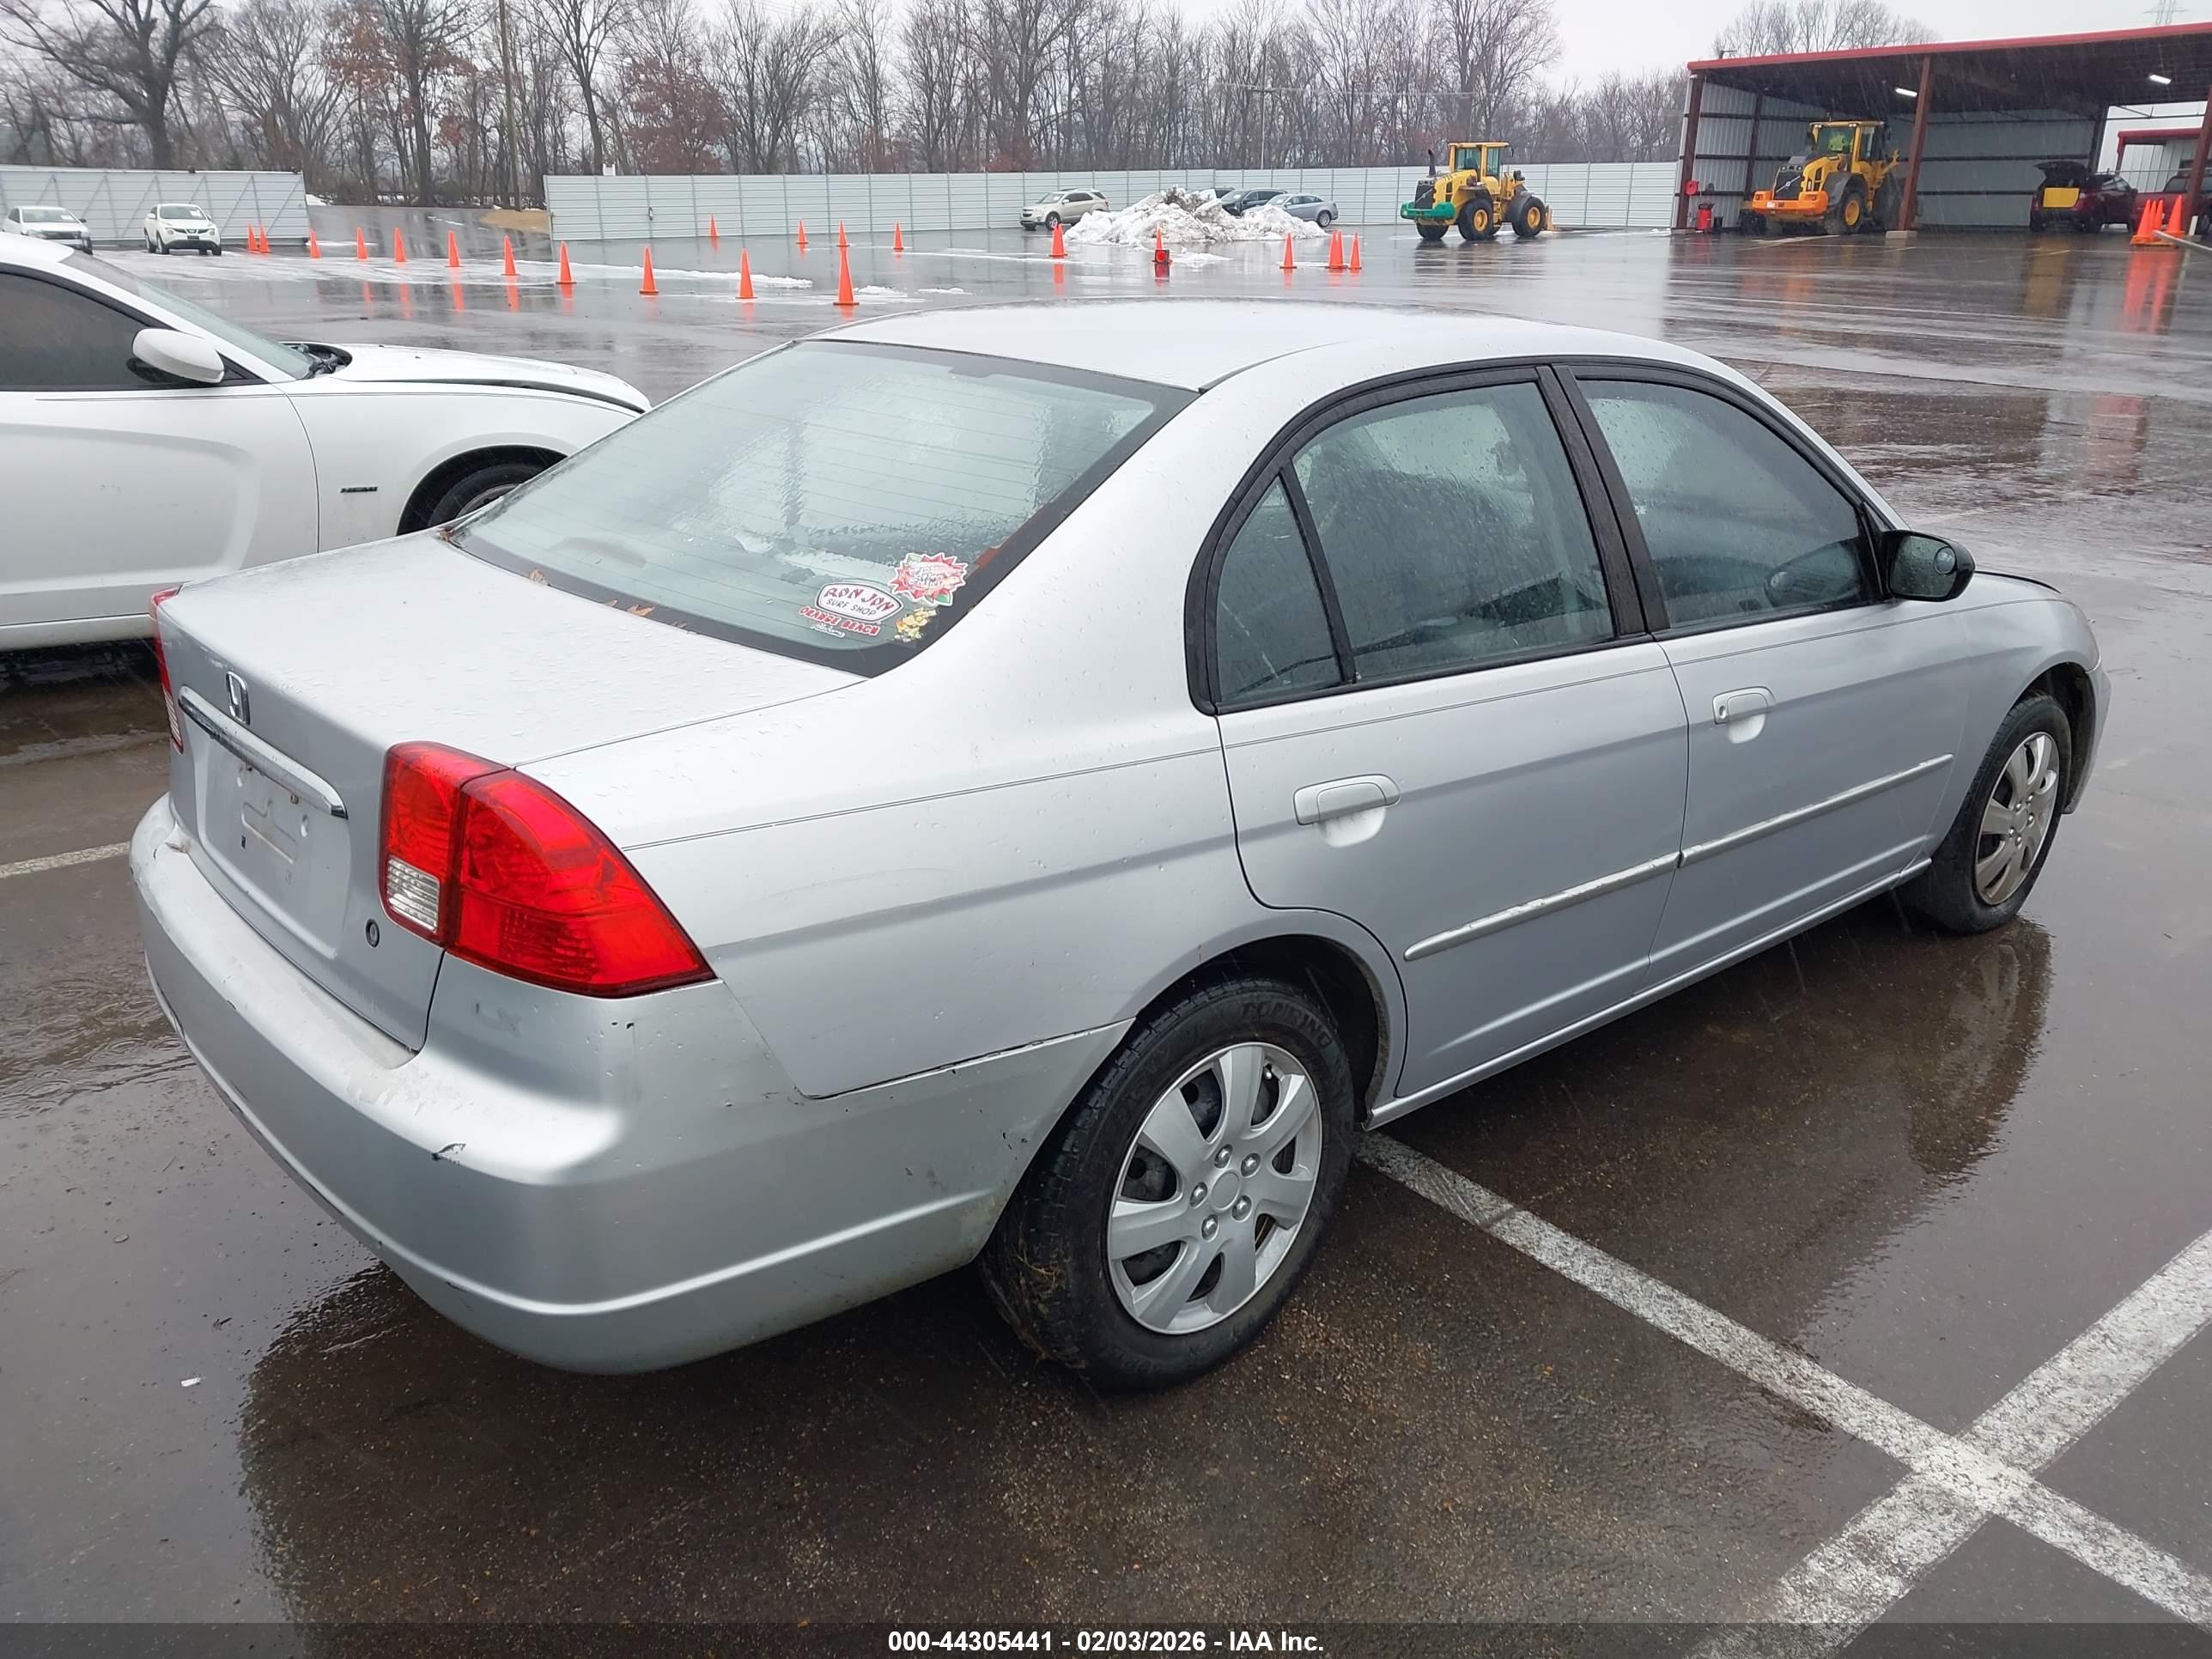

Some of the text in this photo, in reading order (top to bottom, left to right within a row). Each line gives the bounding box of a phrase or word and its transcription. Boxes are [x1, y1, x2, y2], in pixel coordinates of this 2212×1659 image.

[823, 587, 895, 611] RON JON
[826, 599, 877, 617] SURF SHOP
[799, 606, 840, 624] ORANGE
[842, 620, 879, 635] BEACH
